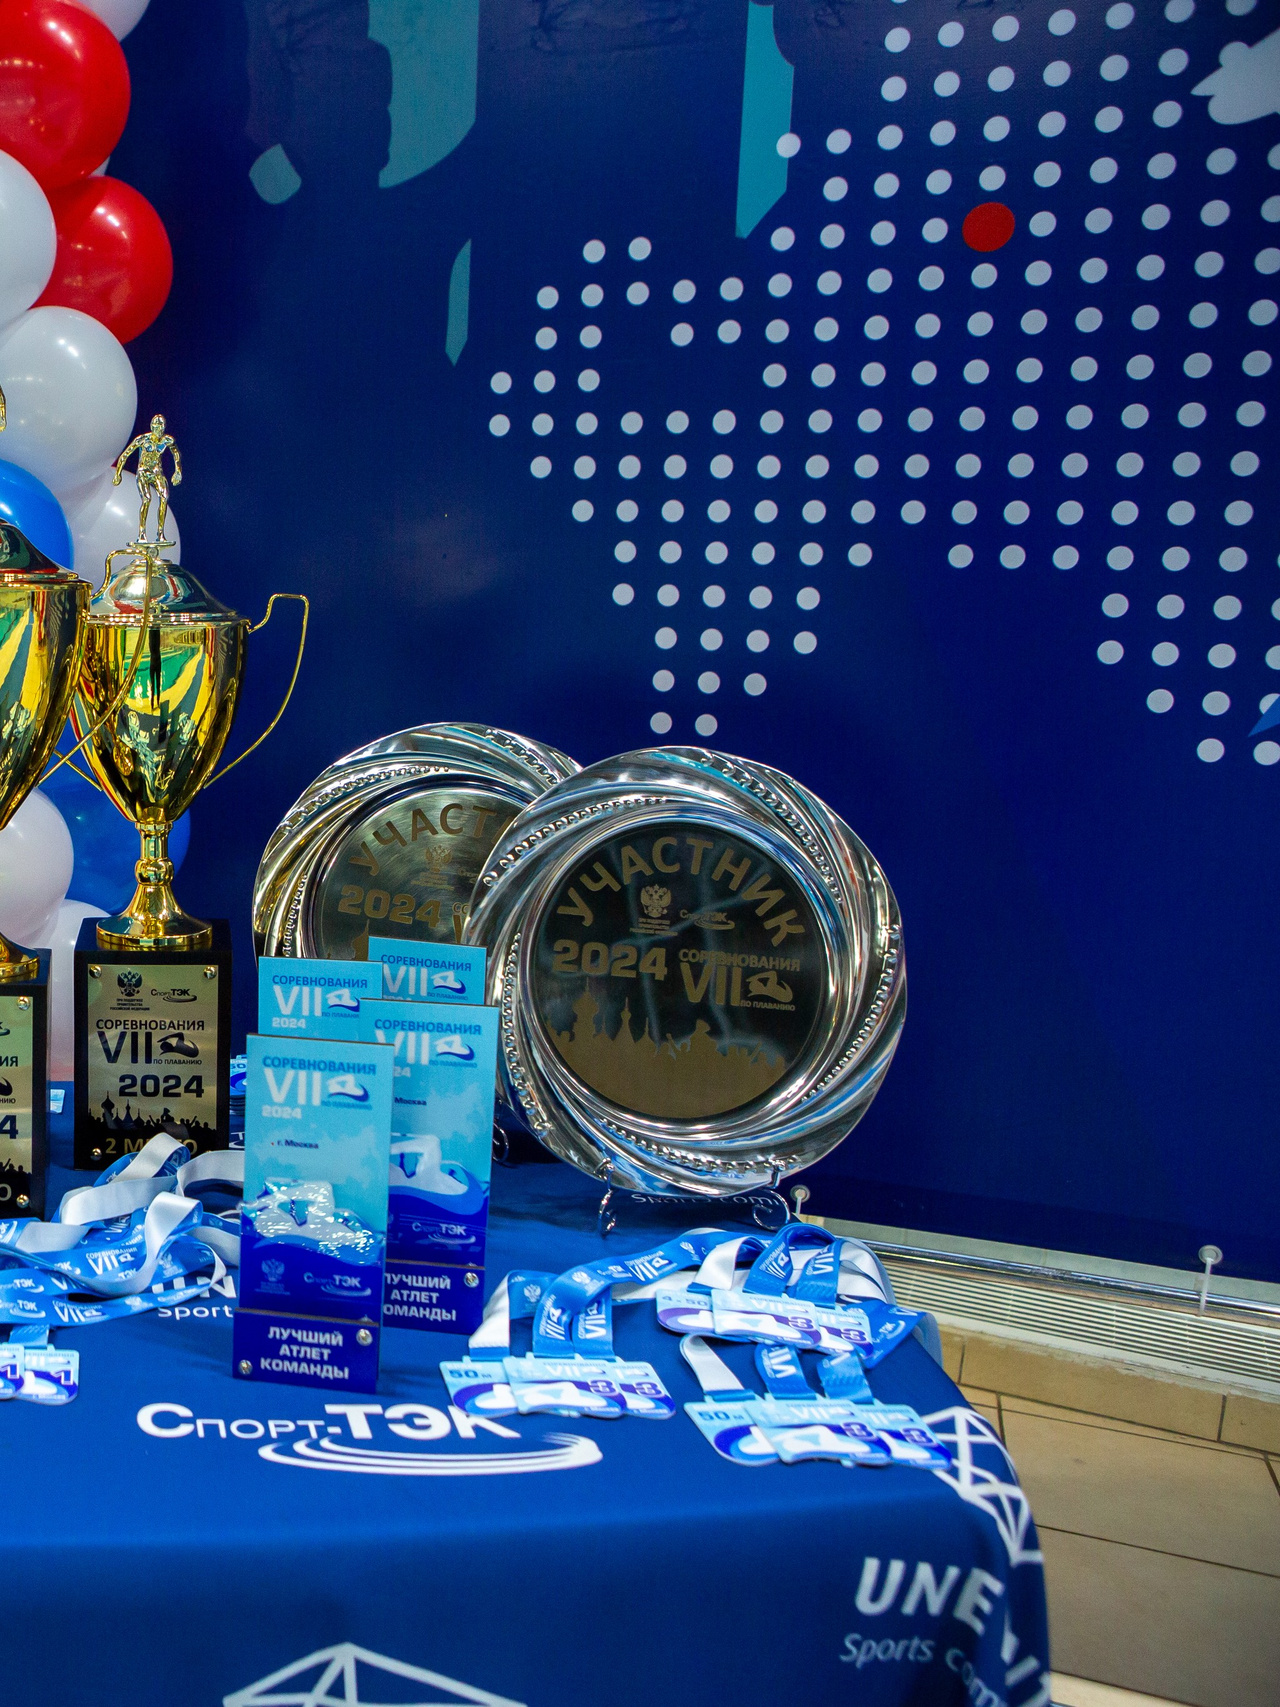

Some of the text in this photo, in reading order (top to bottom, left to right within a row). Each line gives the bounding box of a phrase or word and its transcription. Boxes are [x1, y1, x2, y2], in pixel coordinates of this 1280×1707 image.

[349, 803, 516, 876] УЧАСТ
[557, 836, 805, 947] УЧАСТНИК
[338, 885, 441, 928] 2024
[381, 954, 472, 972] СОРЕВНОВАНИЯ
[552, 939, 668, 981] 2024
[679, 949, 801, 972] СОРЕВНОВАНИЯ
[272, 975, 368, 988] СОРЕВНОВАНИЯ
[383, 964, 428, 996] VII
[680, 962, 742, 1007] VII
[273, 985, 322, 1017] VII
[96, 1018, 205, 1031] СОРЕВНОВАНИЯ
[272, 1017, 306, 1029] 2024
[374, 1019, 482, 1035] СОРЕВНОВАНИЯ
[97, 1031, 152, 1064] VII
[375, 1029, 430, 1066] VII
[262, 1056, 376, 1076] СОРЕВНОВАНИЯ
[118, 1073, 205, 1098] 2024
[263, 1067, 322, 1106] VII
[261, 1104, 302, 1119] 2024
[105, 1137, 117, 1154] 2
[88, 1254, 118, 1275] VII
[390, 1289, 439, 1304] АТЛЕТ
[383, 1304, 456, 1322] ОМАНДЫ
[268, 1326, 343, 1347] ЛУЧШИЙ
[279, 1344, 331, 1361] АТЛЕТ
[260, 1357, 349, 1380] КОМАНДЫ
[839, 1632, 935, 1669] Sports
